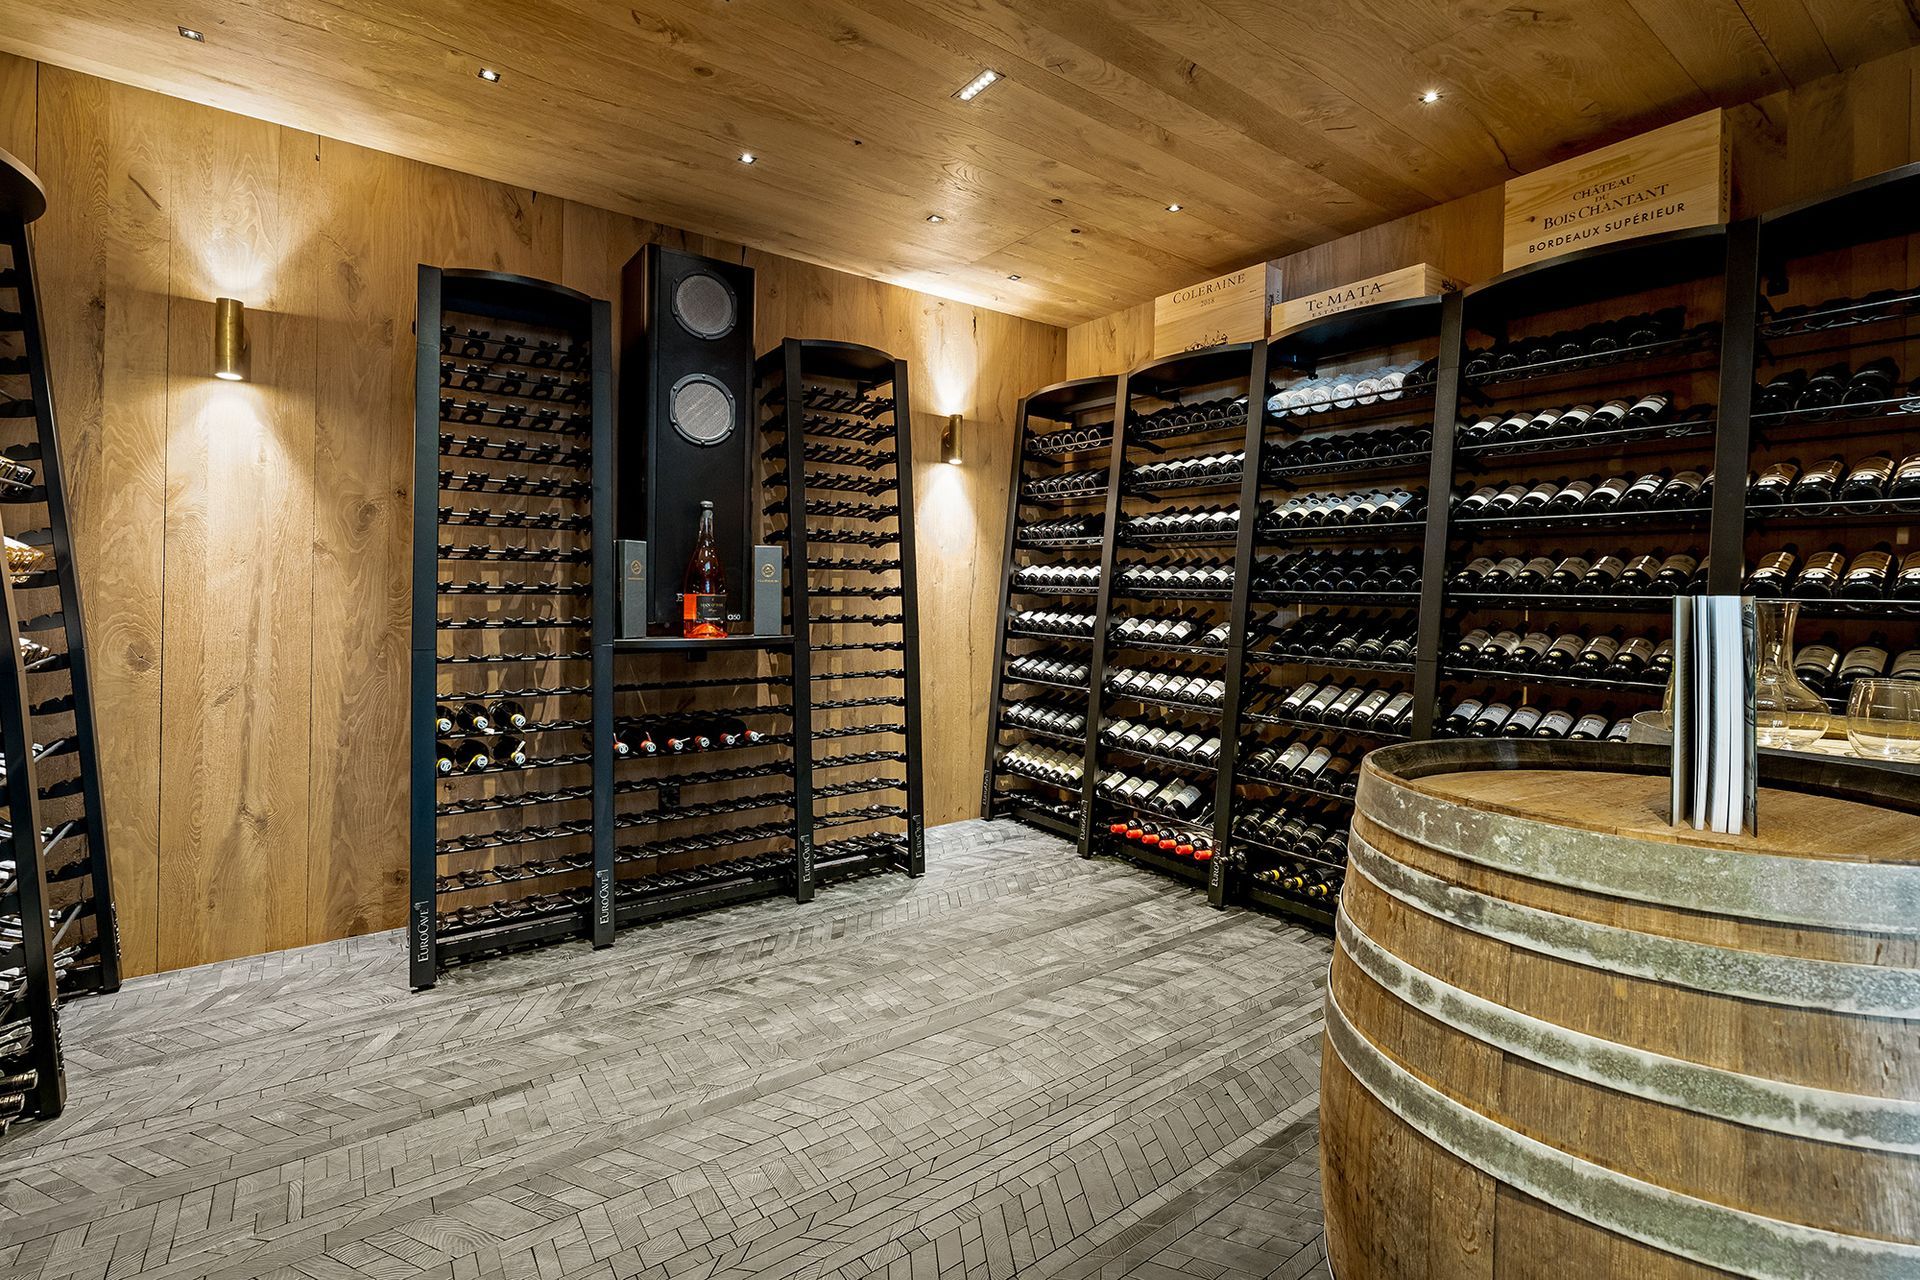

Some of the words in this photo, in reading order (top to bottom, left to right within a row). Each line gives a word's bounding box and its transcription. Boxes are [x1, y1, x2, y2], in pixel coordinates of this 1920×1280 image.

[1572, 174, 1637, 201] CHÂTEAU
[1595, 193, 1610, 203] DU
[1543, 212, 1576, 230] BOIS
[1578, 183, 1670, 219] CHANTANT
[1528, 227, 1600, 254] BORDEAUX
[1604, 202, 1686, 233] SUPÉRIEUR
[1172, 273, 1246, 304] COLERAINE
[1305, 299, 1323, 312] Te
[1327, 282, 1382, 307] MATA
[1311, 304, 1348, 318] ESTATE
